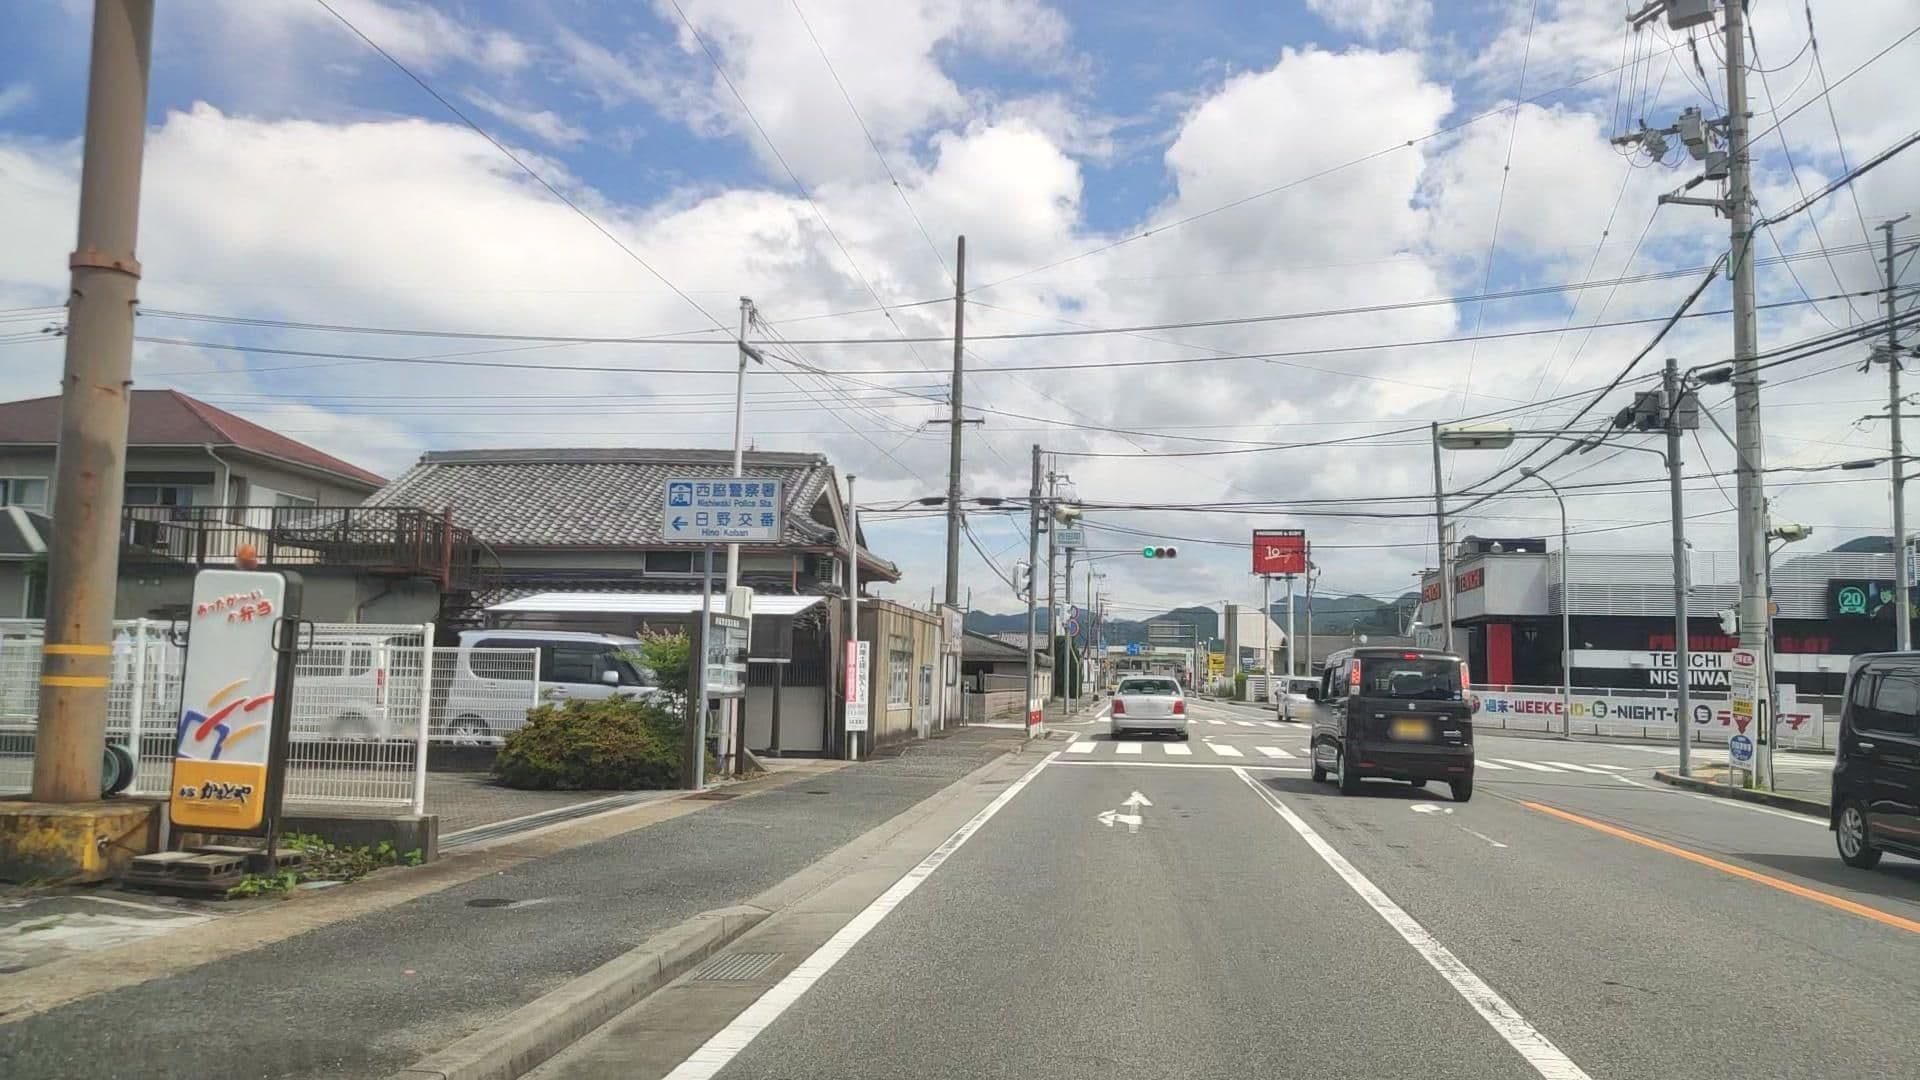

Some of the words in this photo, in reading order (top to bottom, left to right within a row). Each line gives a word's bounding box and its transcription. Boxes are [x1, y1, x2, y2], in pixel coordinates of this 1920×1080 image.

[696, 483, 775, 497] 西脇警察署
[734, 500, 756, 508] Police
[695, 511, 776, 527] 日野交番
[1843, 592, 1861, 605] 20
